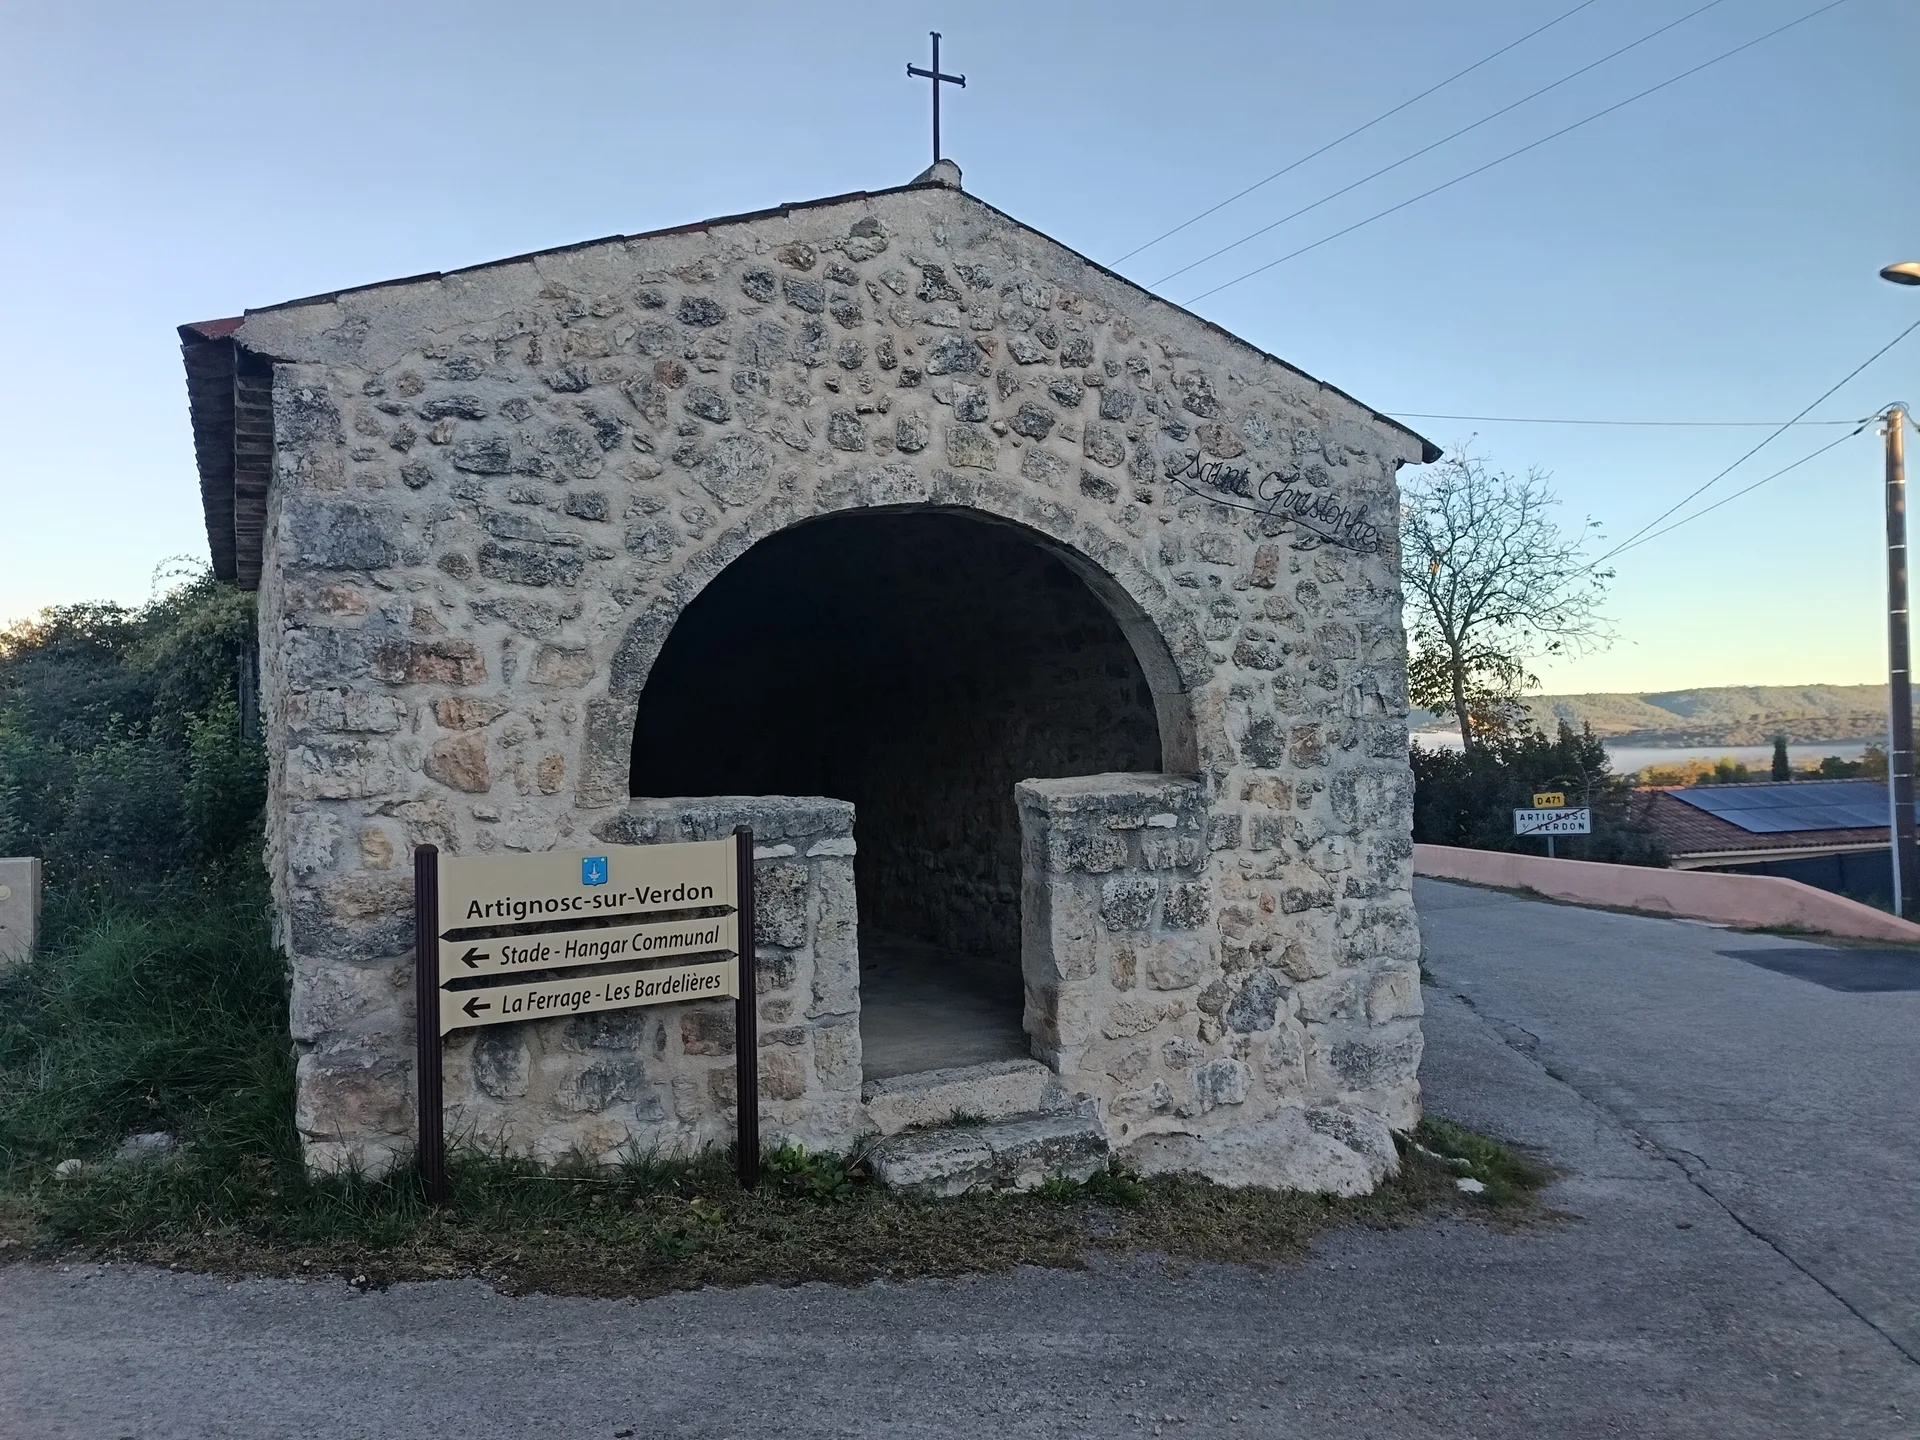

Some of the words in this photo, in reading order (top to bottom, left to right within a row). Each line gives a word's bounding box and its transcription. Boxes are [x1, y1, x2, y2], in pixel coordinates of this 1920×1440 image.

[1258, 471, 1378, 545] Christophe
[1520, 812, 1586, 821] ARTIGNOSC
[1537, 797, 1543, 805] D
[1545, 796, 1561, 804] 471
[1536, 823, 1585, 831] VERDON
[466, 883, 714, 920] Artignosc-sur-Verdon
[500, 943, 550, 966] Stade
[564, 938, 628, 961] Hangar
[632, 925, 720, 952] Communal
[502, 995, 522, 1014] La
[527, 988, 591, 1012] Ferrage
[605, 982, 630, 1002] Les
[634, 973, 721, 998] Bardelières
